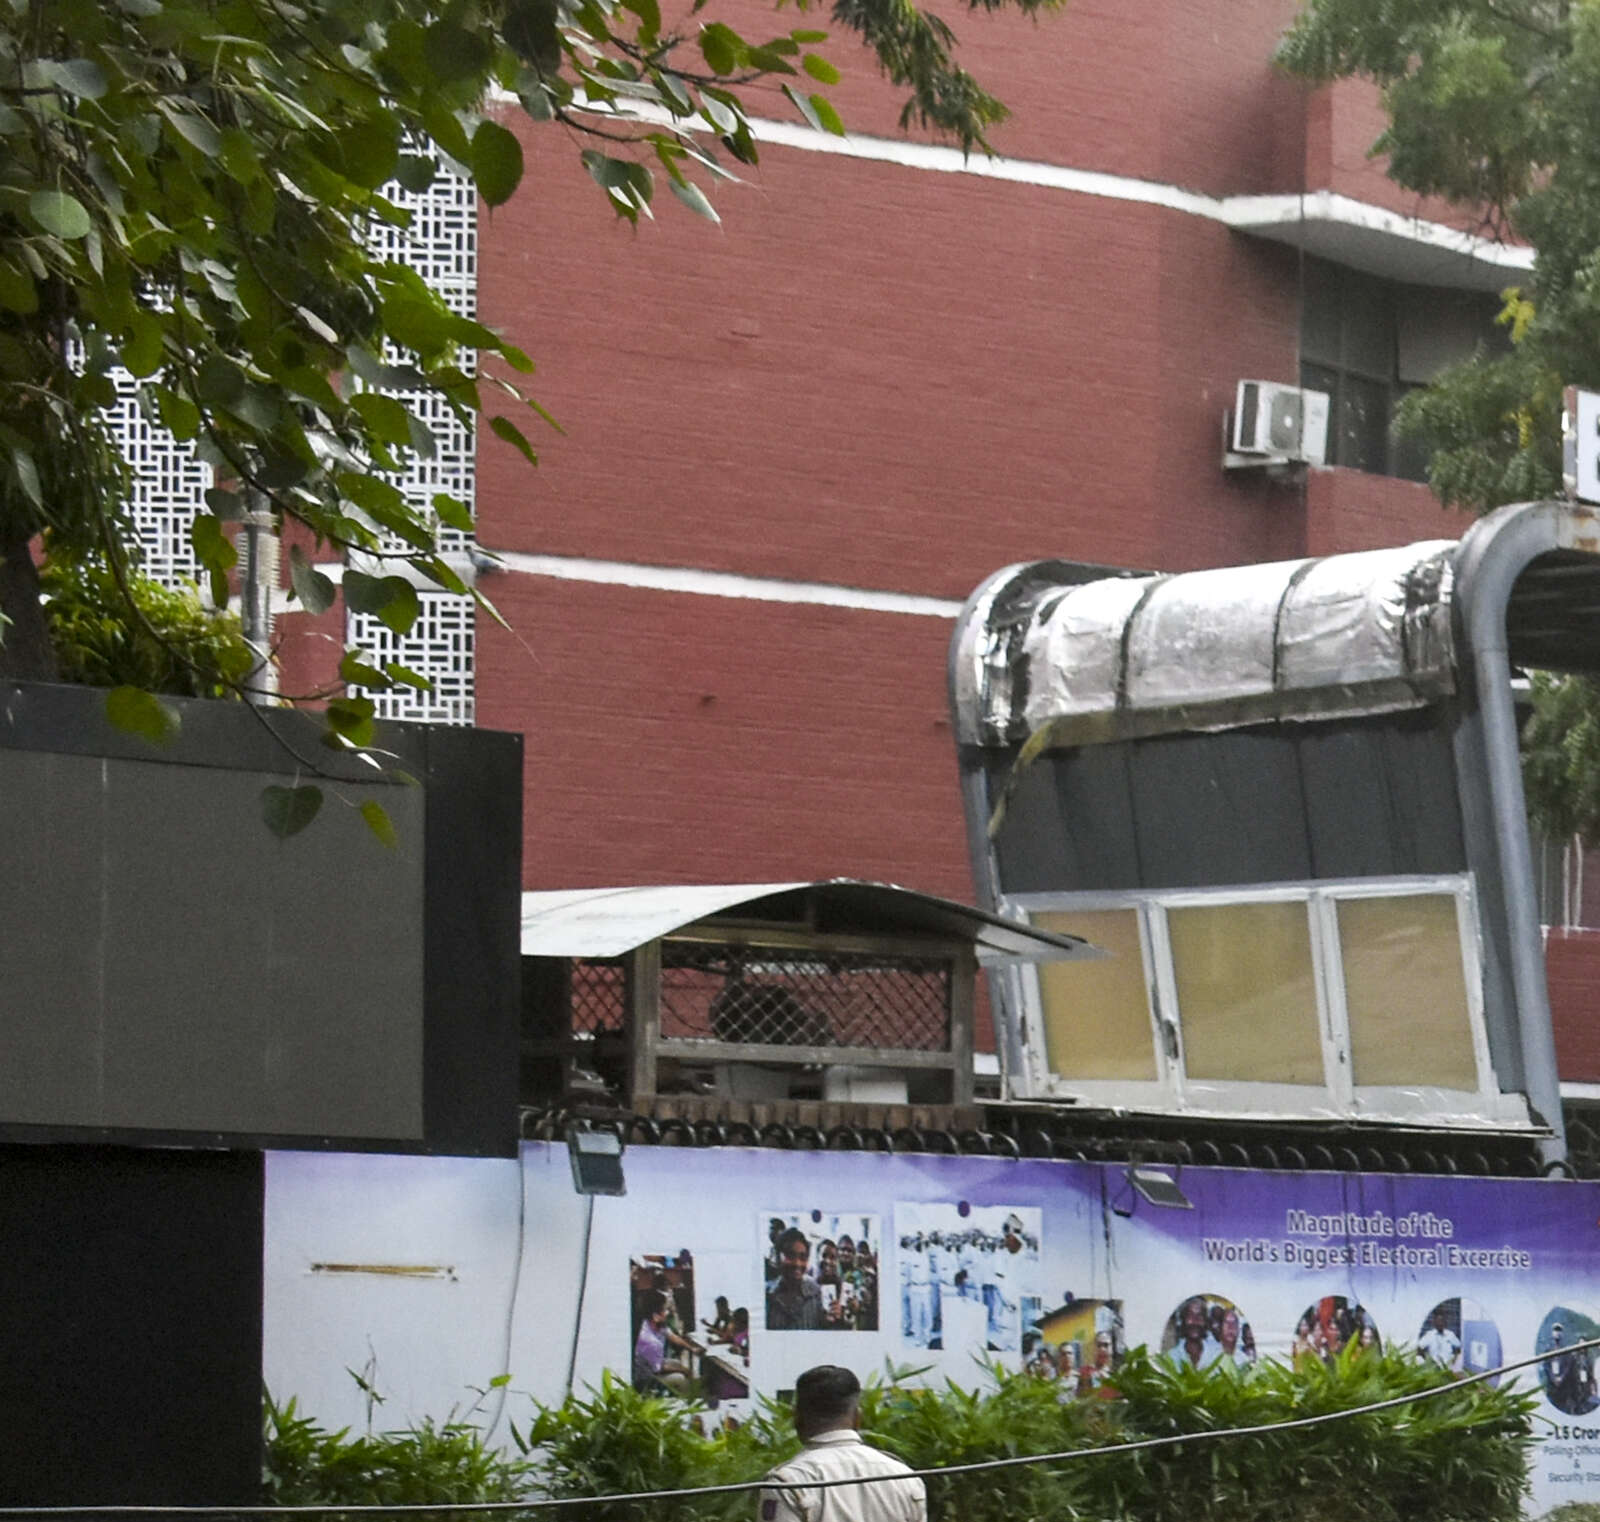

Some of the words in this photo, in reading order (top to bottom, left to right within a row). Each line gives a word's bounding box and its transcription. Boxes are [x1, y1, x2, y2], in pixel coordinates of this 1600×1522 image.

[1287, 1209, 1394, 1239] Magnitude
[1398, 1211, 1419, 1237] of
[1420, 1213, 1453, 1238] the
[1205, 1239, 1278, 1265] World's
[1283, 1242, 1356, 1269] Biggest
[1360, 1242, 1443, 1268] Electoral
[1448, 1245, 1530, 1269] Excercise
